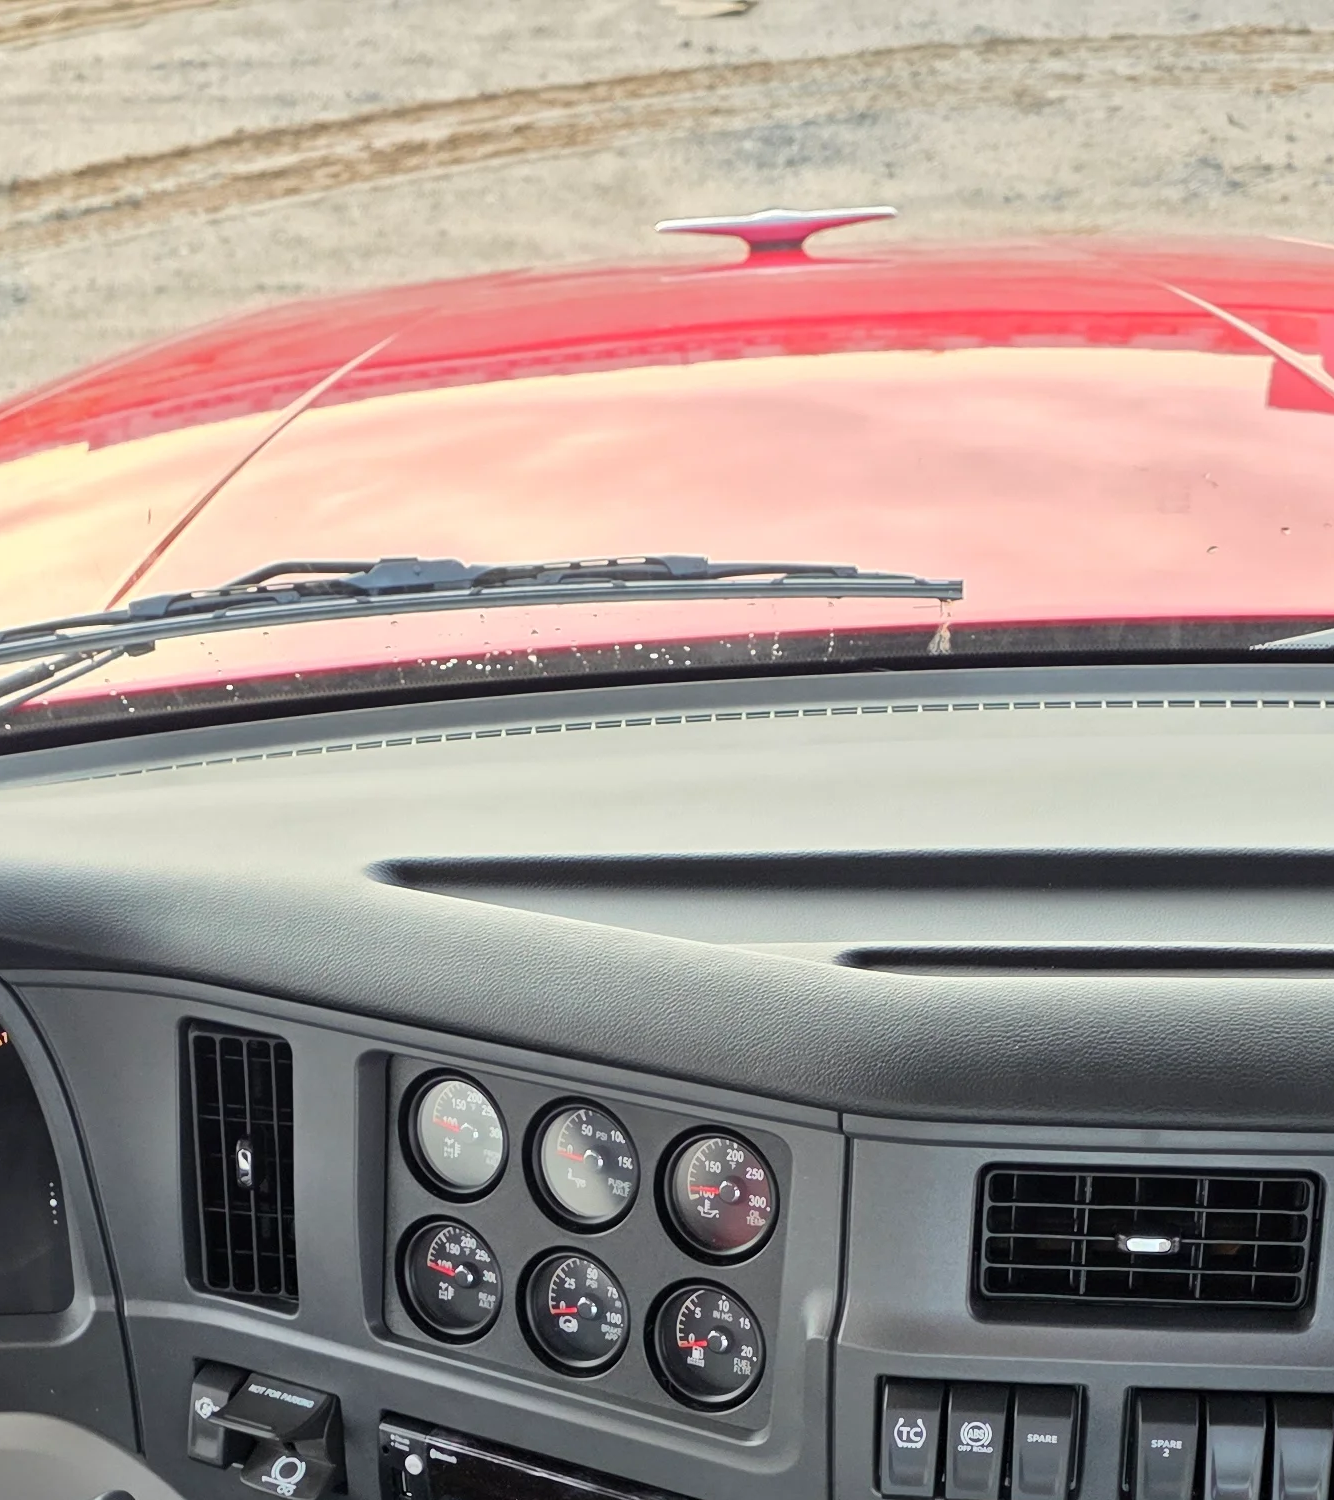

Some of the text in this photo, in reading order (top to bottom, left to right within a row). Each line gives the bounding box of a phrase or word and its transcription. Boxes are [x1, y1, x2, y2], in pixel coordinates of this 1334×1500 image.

[452, 1098, 467, 1111] 150
[581, 1124, 593, 1136] 50
[595, 1131, 608, 1141] PSI
[726, 1149, 744, 1163] 200
[705, 1160, 722, 1174] 150
[746, 1167, 765, 1181] 250
[748, 1194, 766, 1208] 300
[746, 1217, 766, 1226] TEMP
[461, 1236, 477, 1249] 200
[445, 1242, 460, 1256] 150
[586, 1267, 598, 1280] 50
[564, 1277, 576, 1289] 25
[586, 1279, 598, 1289] PSI
[606, 1285, 618, 1299] 75
[718, 1300, 730, 1312] 10
[606, 1312, 622, 1325] 100
[694, 1307, 702, 1319] 5
[713, 1310, 733, 1322] IN HG
[739, 1317, 751, 1330] 15
[741, 1345, 753, 1358] 20
[733, 1357, 751, 1368] FUEL
[733, 1365, 751, 1375] FLTR
[899, 1426, 922, 1441] TC
[967, 1429, 985, 1440] ABS
[1027, 1433, 1058, 1444] SPARE
[972, 1446, 993, 1454] ROAD
[1151, 1439, 1183, 1450] SPARE
[1162, 1449, 1170, 1457] 2
